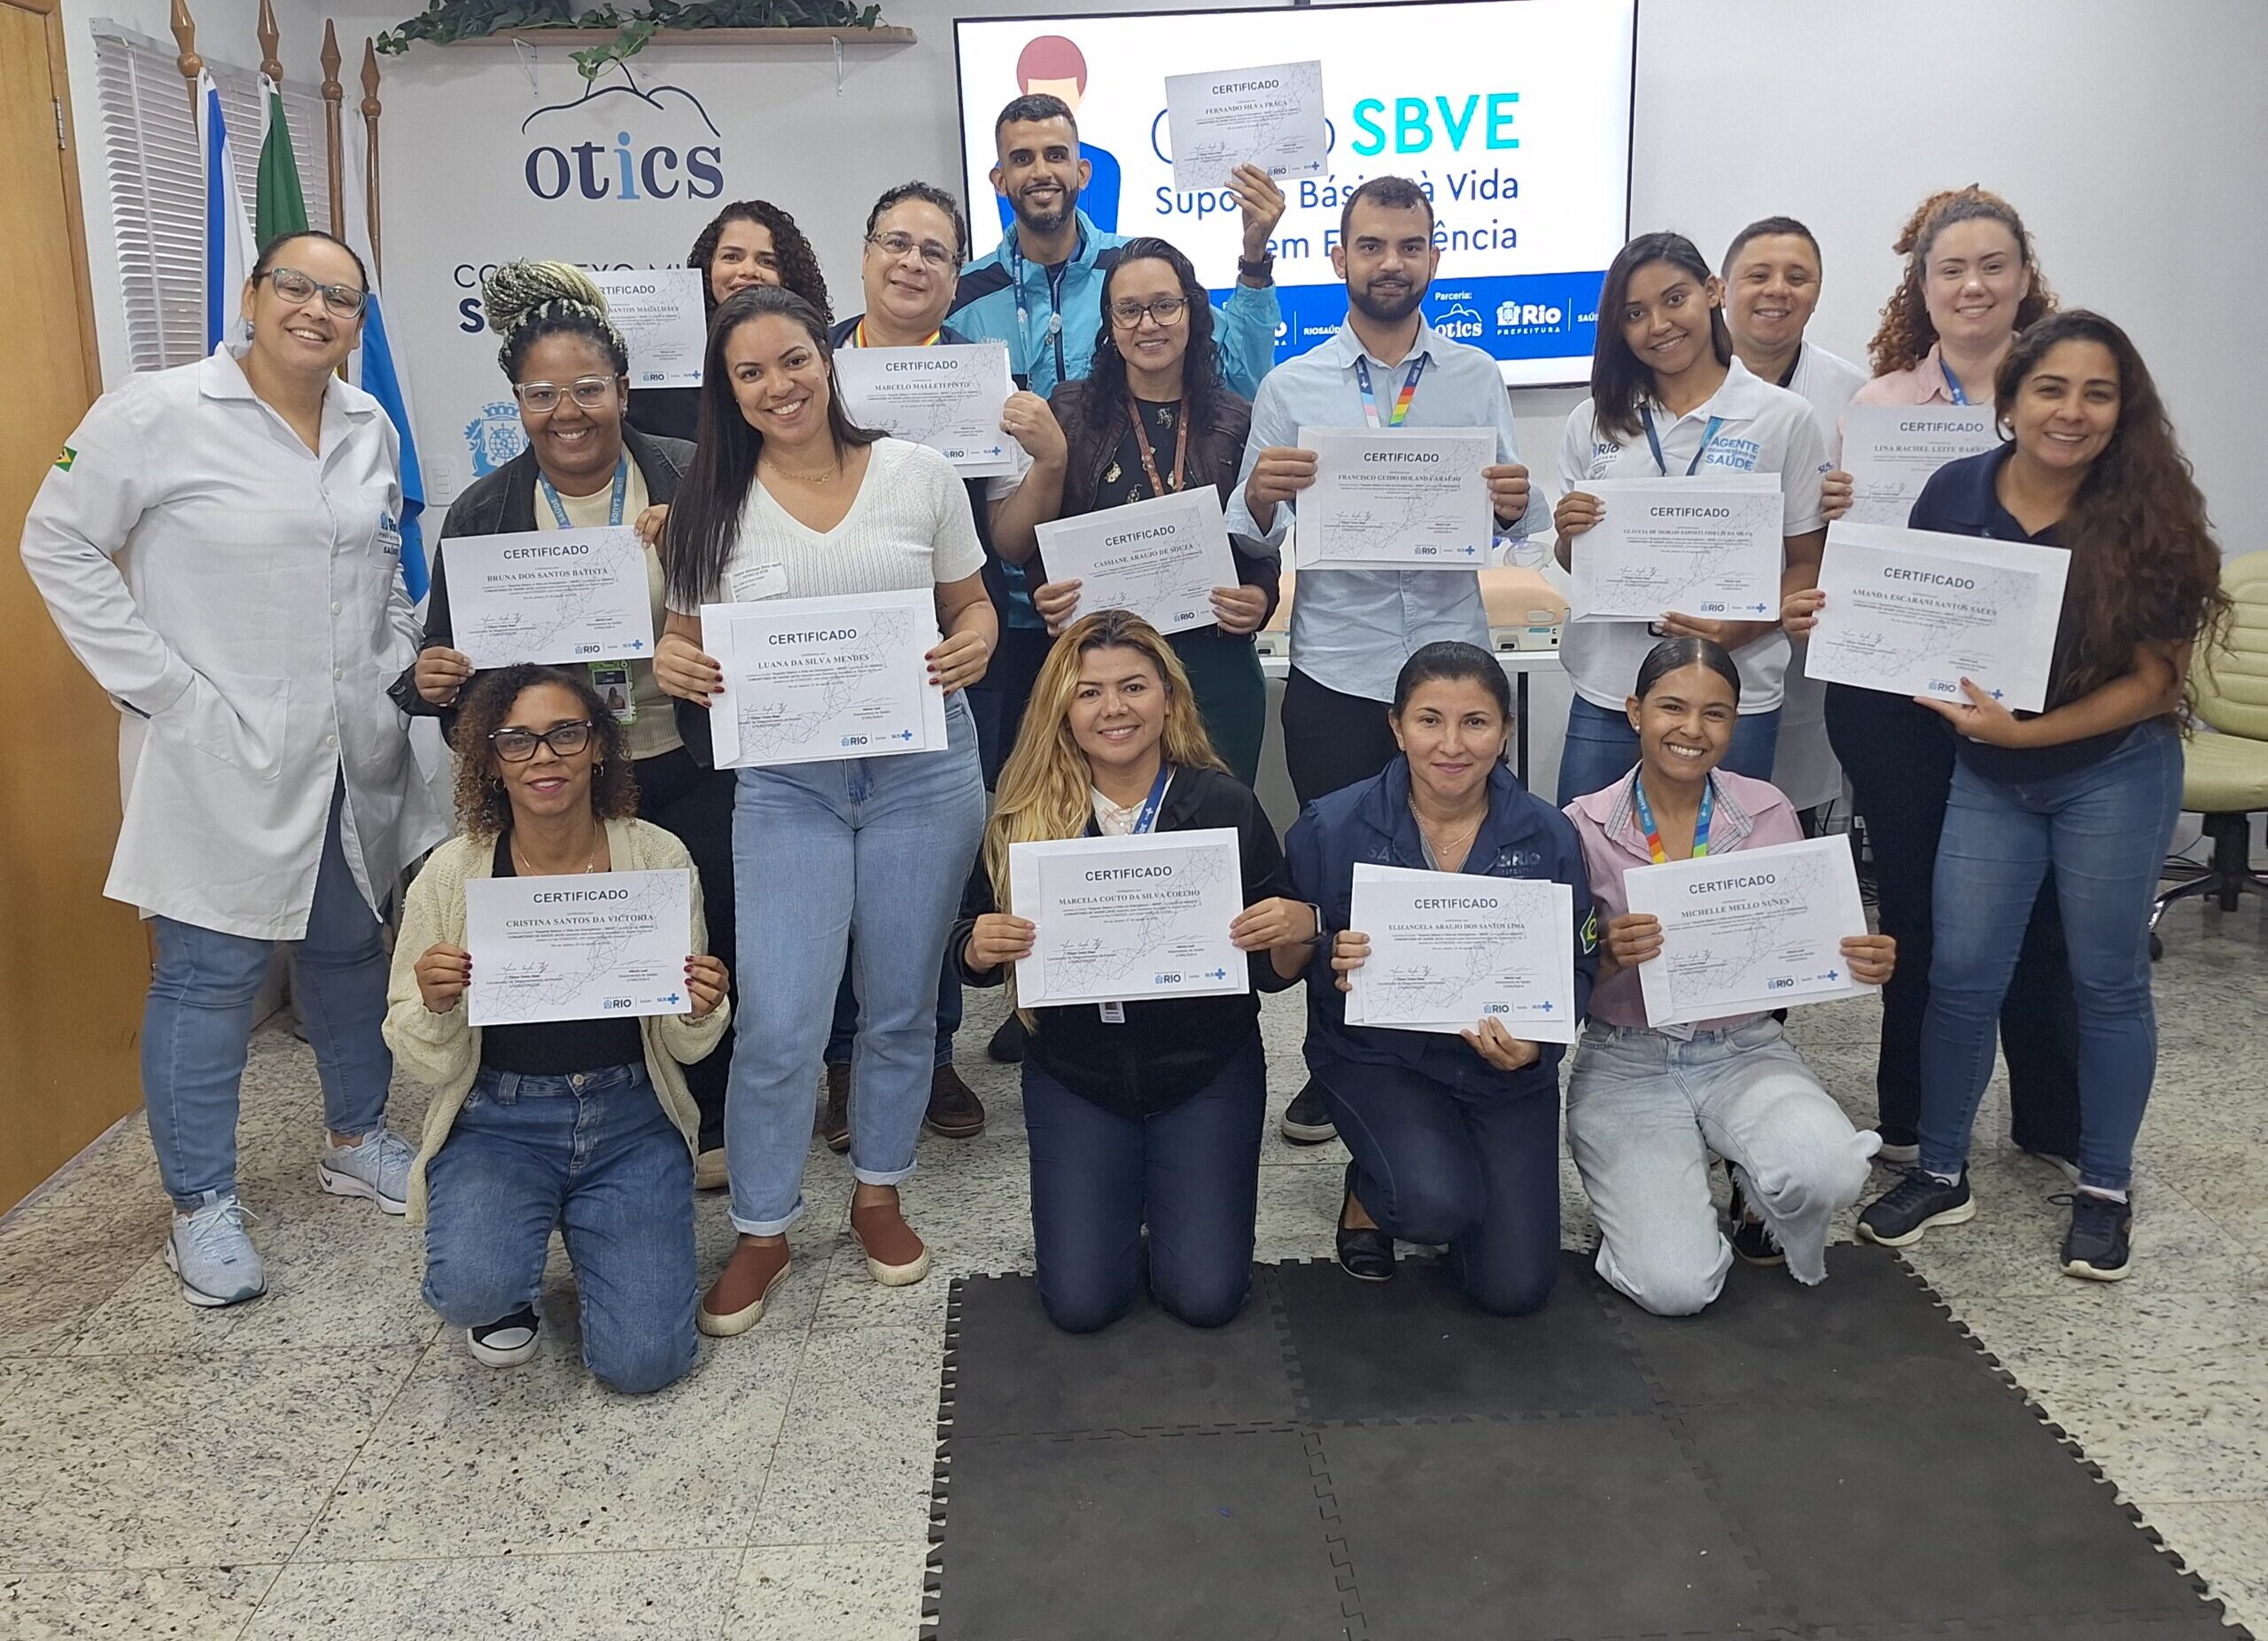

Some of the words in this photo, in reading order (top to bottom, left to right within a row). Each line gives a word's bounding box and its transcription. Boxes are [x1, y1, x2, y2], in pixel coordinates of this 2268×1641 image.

[1212, 79, 1279, 95] CERTIFICADO
[1206, 105, 1242, 115] FERNANDO
[1244, 102, 1263, 111] SILVA
[1352, 92, 1520, 156] SBVE
[524, 131, 724, 200] otics
[1447, 167, 1518, 201] Vida
[1267, 237, 1309, 259] em
[1324, 219, 1518, 258] Eência
[601, 284, 656, 295] RTIFICADO
[1434, 291, 1472, 300] Parceria:
[1435, 320, 1483, 338] otics
[1522, 304, 1562, 325] Rio
[1303, 324, 1343, 336] RIOSAÚD
[1497, 325, 1561, 336] PREFEITURA
[885, 360, 958, 371] CERTIFICADO
[649, 373, 664, 382] RIO
[1899, 422, 1984, 432] CERTIFICADO
[1711, 437, 1759, 454] AGENTE
[1363, 452, 1440, 463] CERTIFICADO
[1651, 506, 1730, 517] CERTIFICADO
[1105, 525, 1177, 547] CERTIFICADO
[503, 544, 589, 560] CERTIFICADO
[1093, 556, 1129, 568] CASSIANE
[1169, 543, 1194, 553] SOUZA
[487, 572, 517, 582] BRUNA
[518, 572, 536, 580] DOS
[537, 570, 571, 579] SANTOS
[572, 567, 608, 577] BATISTA
[1884, 566, 1975, 590] CERTIFICADO
[1852, 588, 1888, 600] AMANDA
[1934, 600, 1969, 611] SANTOS
[1708, 603, 1725, 612] RIO
[1180, 611, 1195, 621] RIO
[768, 628, 858, 646] CERTIFICADO
[583, 645, 600, 655] RIO
[757, 659, 789, 669] LUANA
[790, 658, 803, 667] DA
[804, 657, 832, 666] SILVA
[833, 653, 870, 664] MENDES
[1938, 682, 1956, 693] RIO
[850, 735, 868, 746] RIO
[1084, 866, 1173, 882] CERTIFICADO
[1689, 874, 1776, 895] CERTIFICADO
[533, 889, 629, 904] CERTIFICADO
[1059, 897, 1098, 906] MARCELA
[1099, 895, 1128, 904] COUTO
[1167, 890, 1200, 898] COELHO
[1414, 898, 1498, 909] CERTIFICADO
[1681, 905, 1728, 919] MICHELLE
[1728, 901, 1760, 914] MELLO
[506, 919, 551, 928] CRISTINA
[553, 917, 590, 926] SANTOS
[608, 914, 654, 922] VICTORIA
[1163, 975, 1181, 984] RIO
[1776, 977, 1794, 989] RIO
[612, 999, 632, 1009] RIO
[1492, 1004, 1510, 1014] RIO
